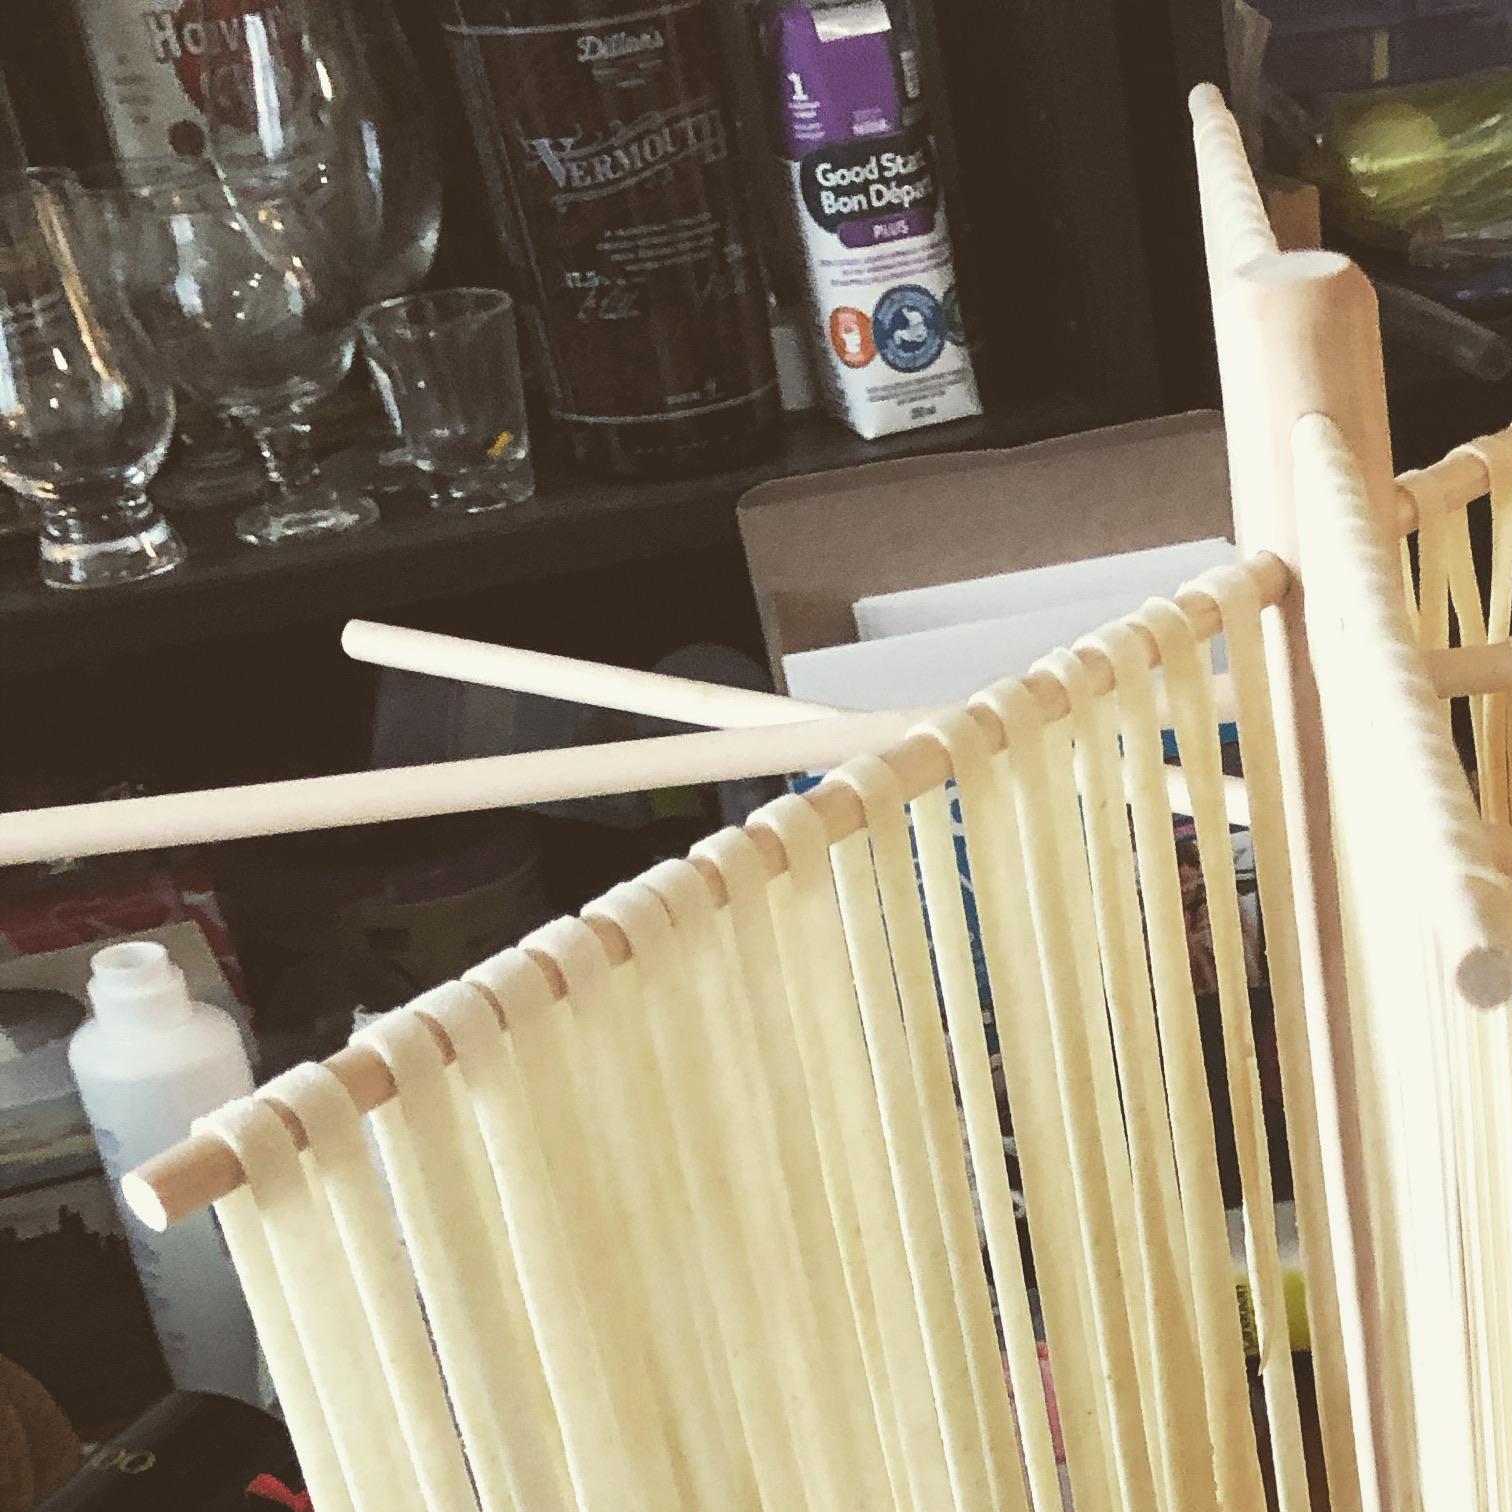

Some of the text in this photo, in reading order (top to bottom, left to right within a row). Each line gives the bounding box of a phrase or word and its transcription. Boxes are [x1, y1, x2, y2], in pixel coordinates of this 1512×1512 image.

[786, 72, 809, 101] 1
[530, 110, 728, 189] VERMOUTH
[815, 156, 880, 187] Good
[820, 191, 869, 216] Bon
